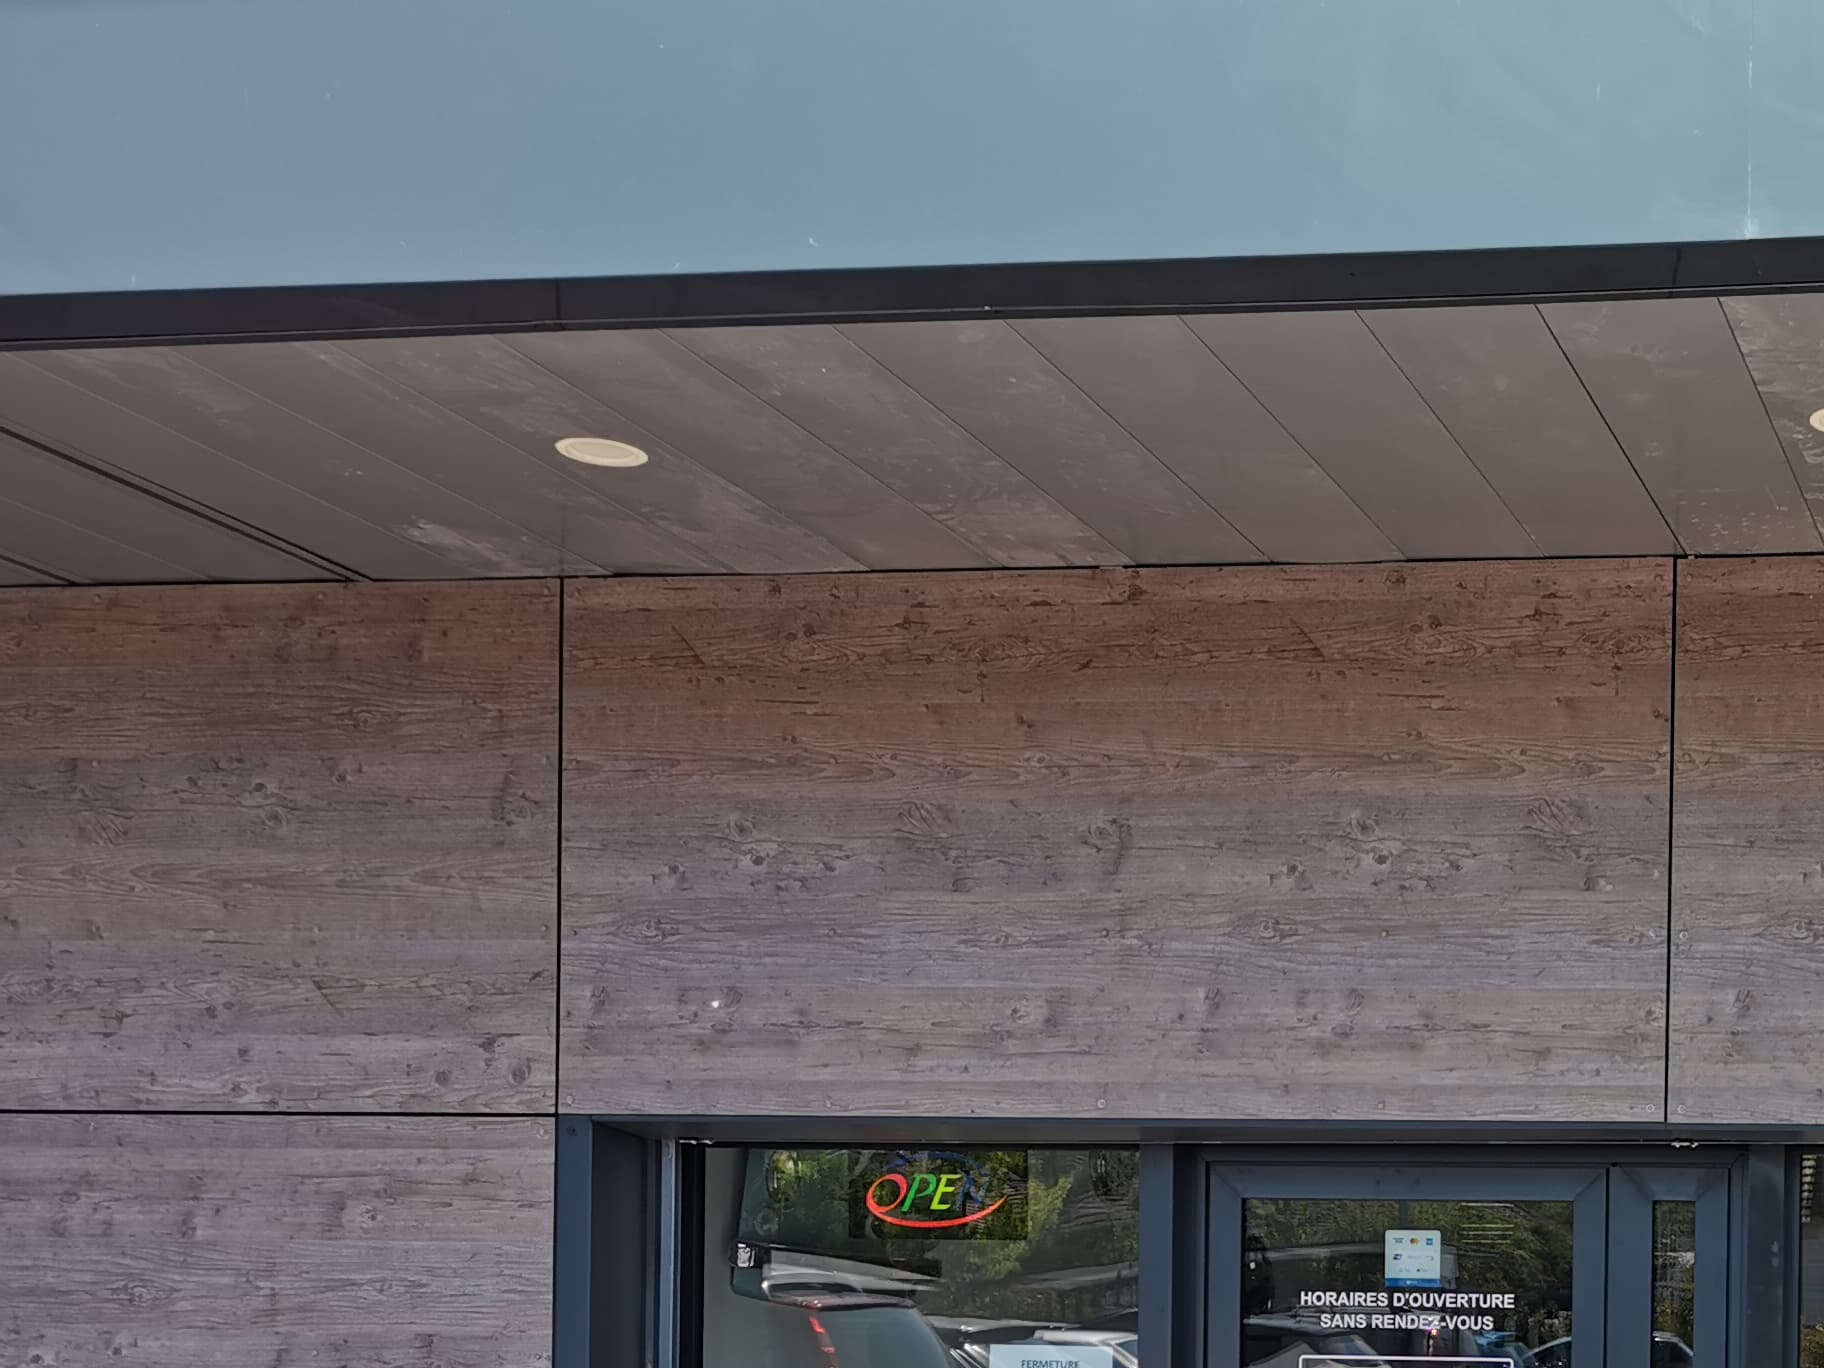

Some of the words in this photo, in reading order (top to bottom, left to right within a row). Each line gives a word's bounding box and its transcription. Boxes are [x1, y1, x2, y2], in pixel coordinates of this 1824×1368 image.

[1300, 1291, 1388, 1308] HORAIRES
[1394, 1292, 1515, 1309] D'OUVERTURE
[1320, 1314, 1369, 1330] SANS
[1372, 1314, 1494, 1331] RENDEZ-VOUS
[1021, 1360, 1080, 1368] FERMETURE
